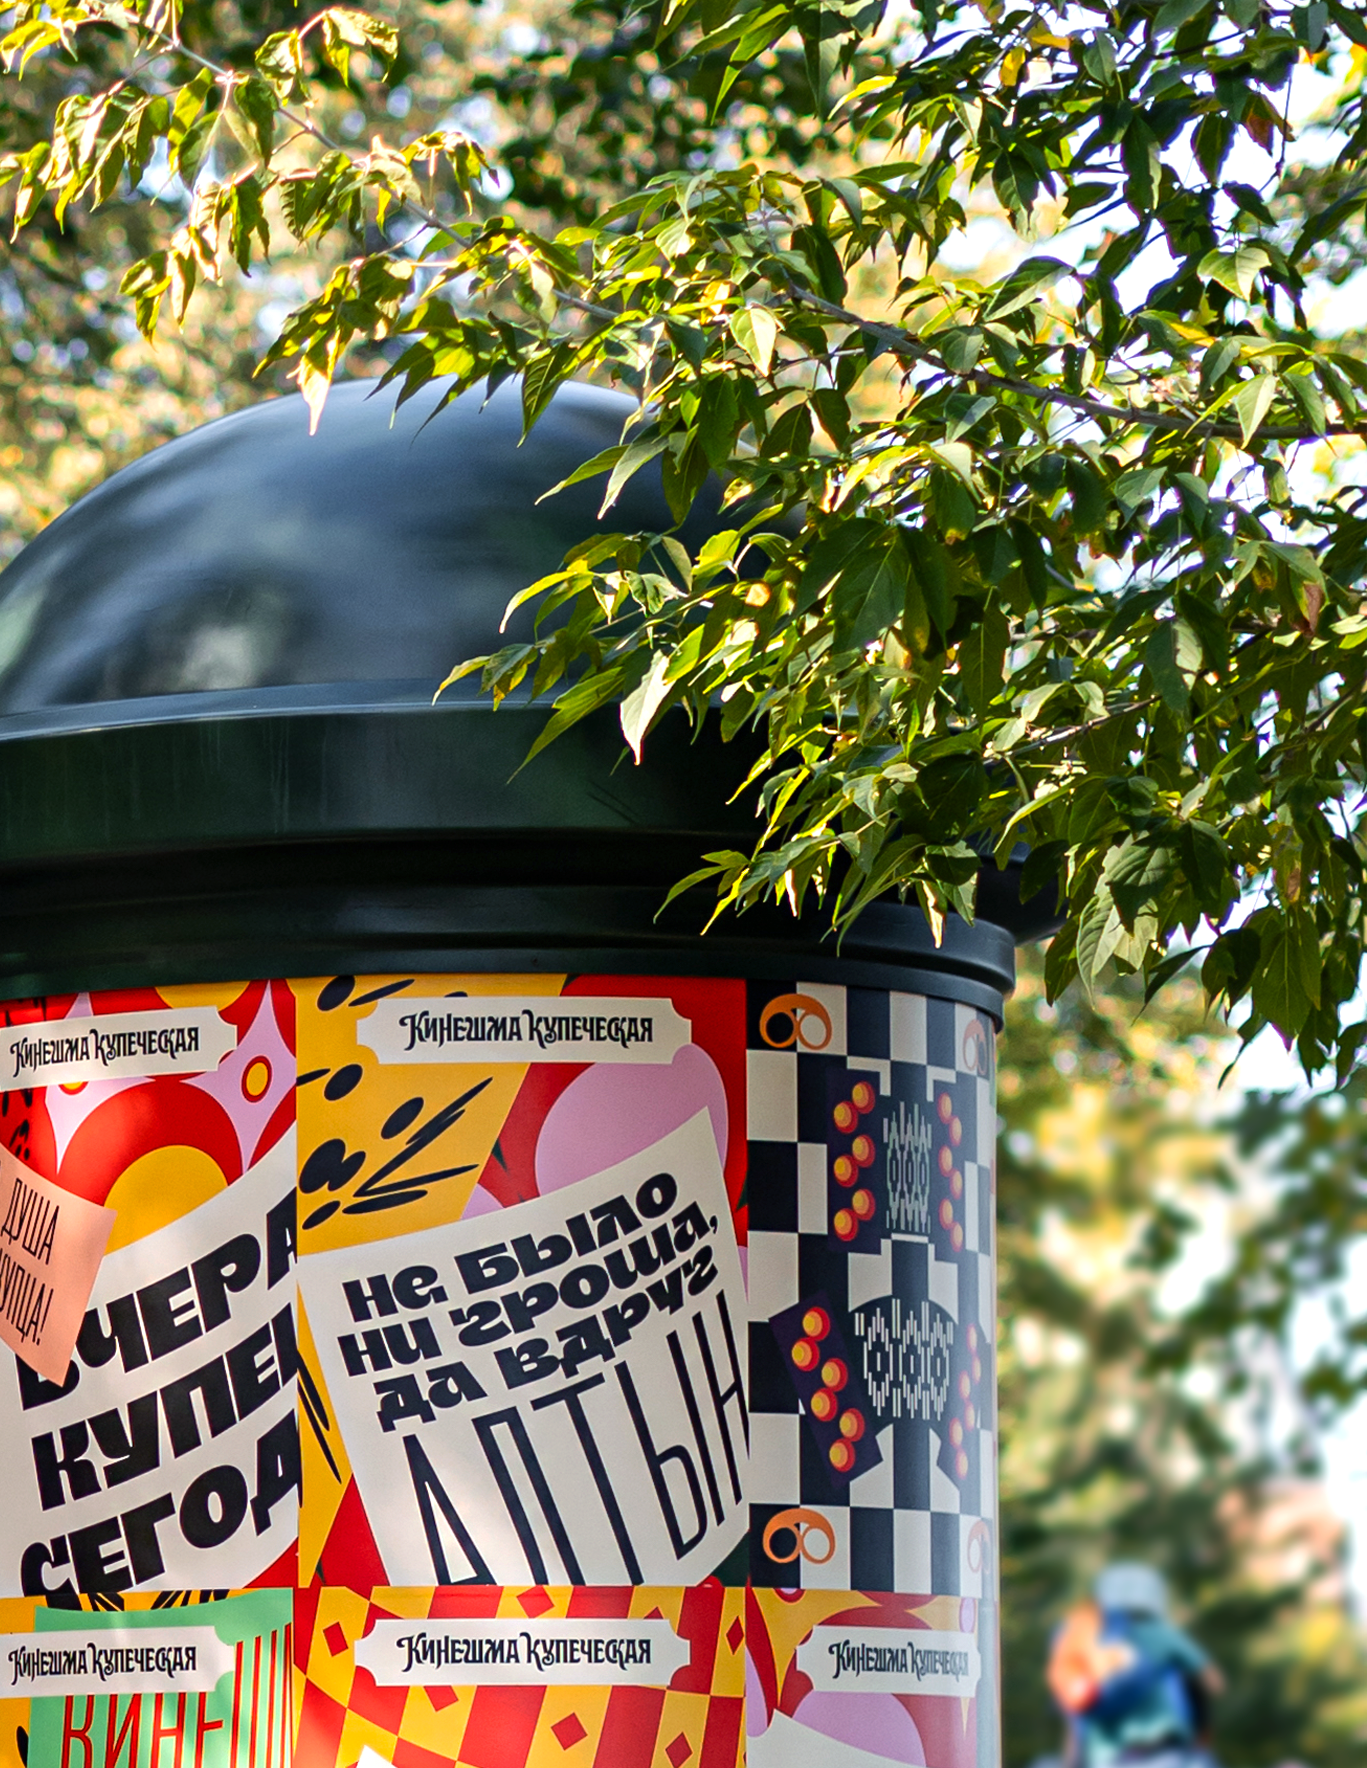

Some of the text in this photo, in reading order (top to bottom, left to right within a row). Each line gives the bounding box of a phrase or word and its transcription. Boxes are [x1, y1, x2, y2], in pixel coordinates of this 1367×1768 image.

[399, 1009, 653, 1050] КИНЕШМА КУПЕЧЕСКАЯ
[10, 1027, 199, 1078] КИНЕШМА КУПЕЧЕСКАЯ
[1, 1178, 60, 1265] ДУША
[8, 1642, 196, 1686] КИНЕШМА КУПЕЧЕСКАЯ
[396, 1631, 651, 1672] КИНЕШМА КУПЕЧЕСКАЯ
